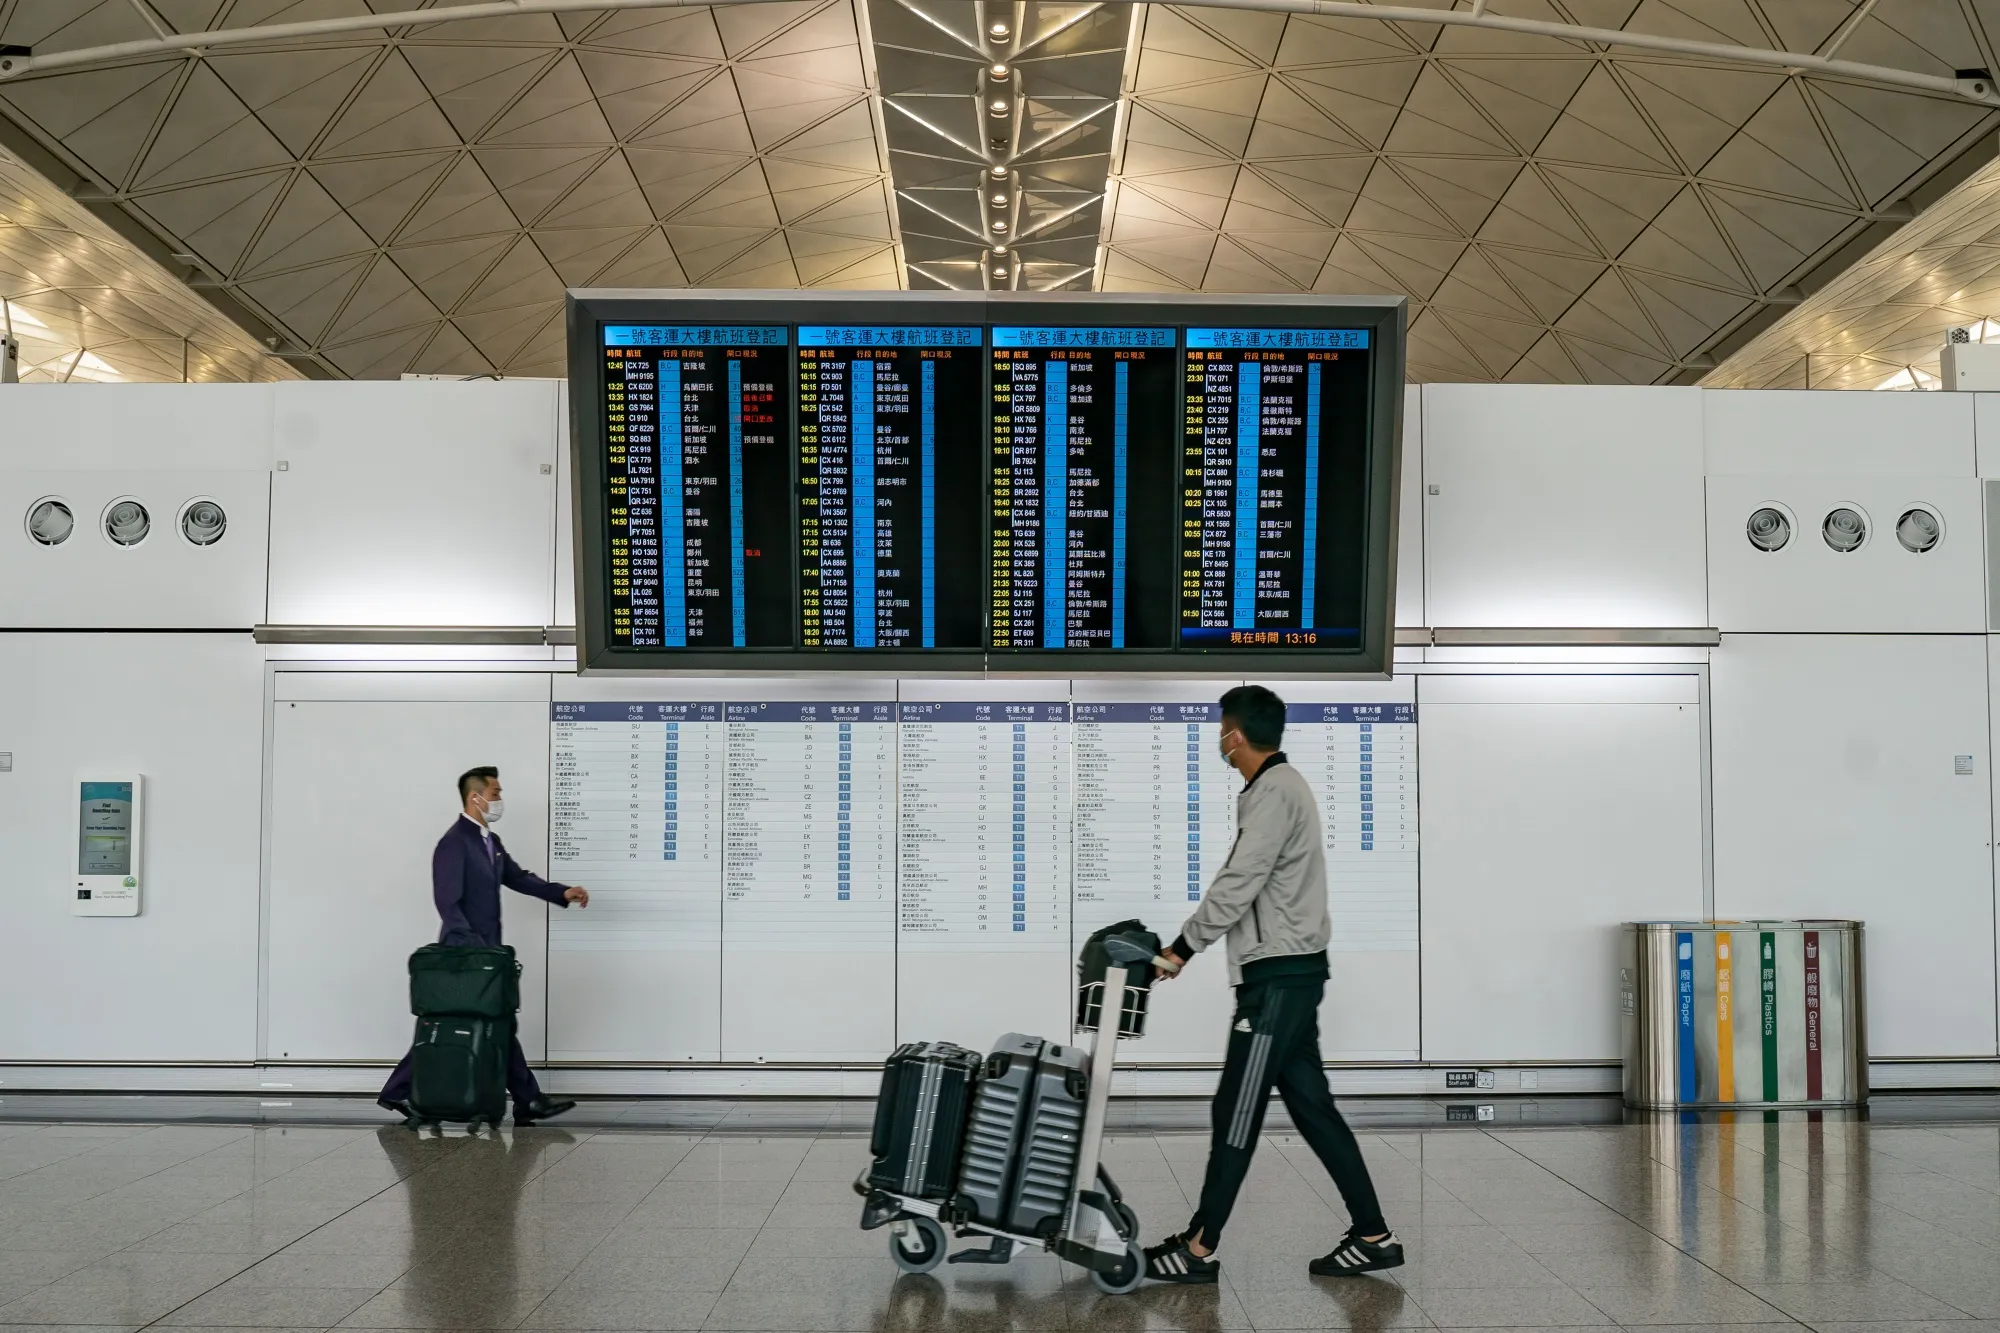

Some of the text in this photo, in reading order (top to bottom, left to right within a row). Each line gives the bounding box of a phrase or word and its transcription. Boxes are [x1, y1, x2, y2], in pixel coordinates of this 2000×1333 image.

[616, 329, 778, 344] 一號客運大樓航班登記
[810, 330, 972, 345] 一號客運大樓航班登記
[1004, 330, 1166, 346] 一號客運大樓航班登記
[1198, 332, 1358, 347] 一號客運大樓航班登記
[1207, 352, 1222, 360] 航班
[1262, 352, 1284, 360] 目的地
[1231, 632, 1316, 643] 現在時間 13:16
[1681, 996, 1691, 1026] Paper
[1765, 995, 1774, 1035] Plastics
[1807, 967, 1818, 1050] 一般廢物 General
